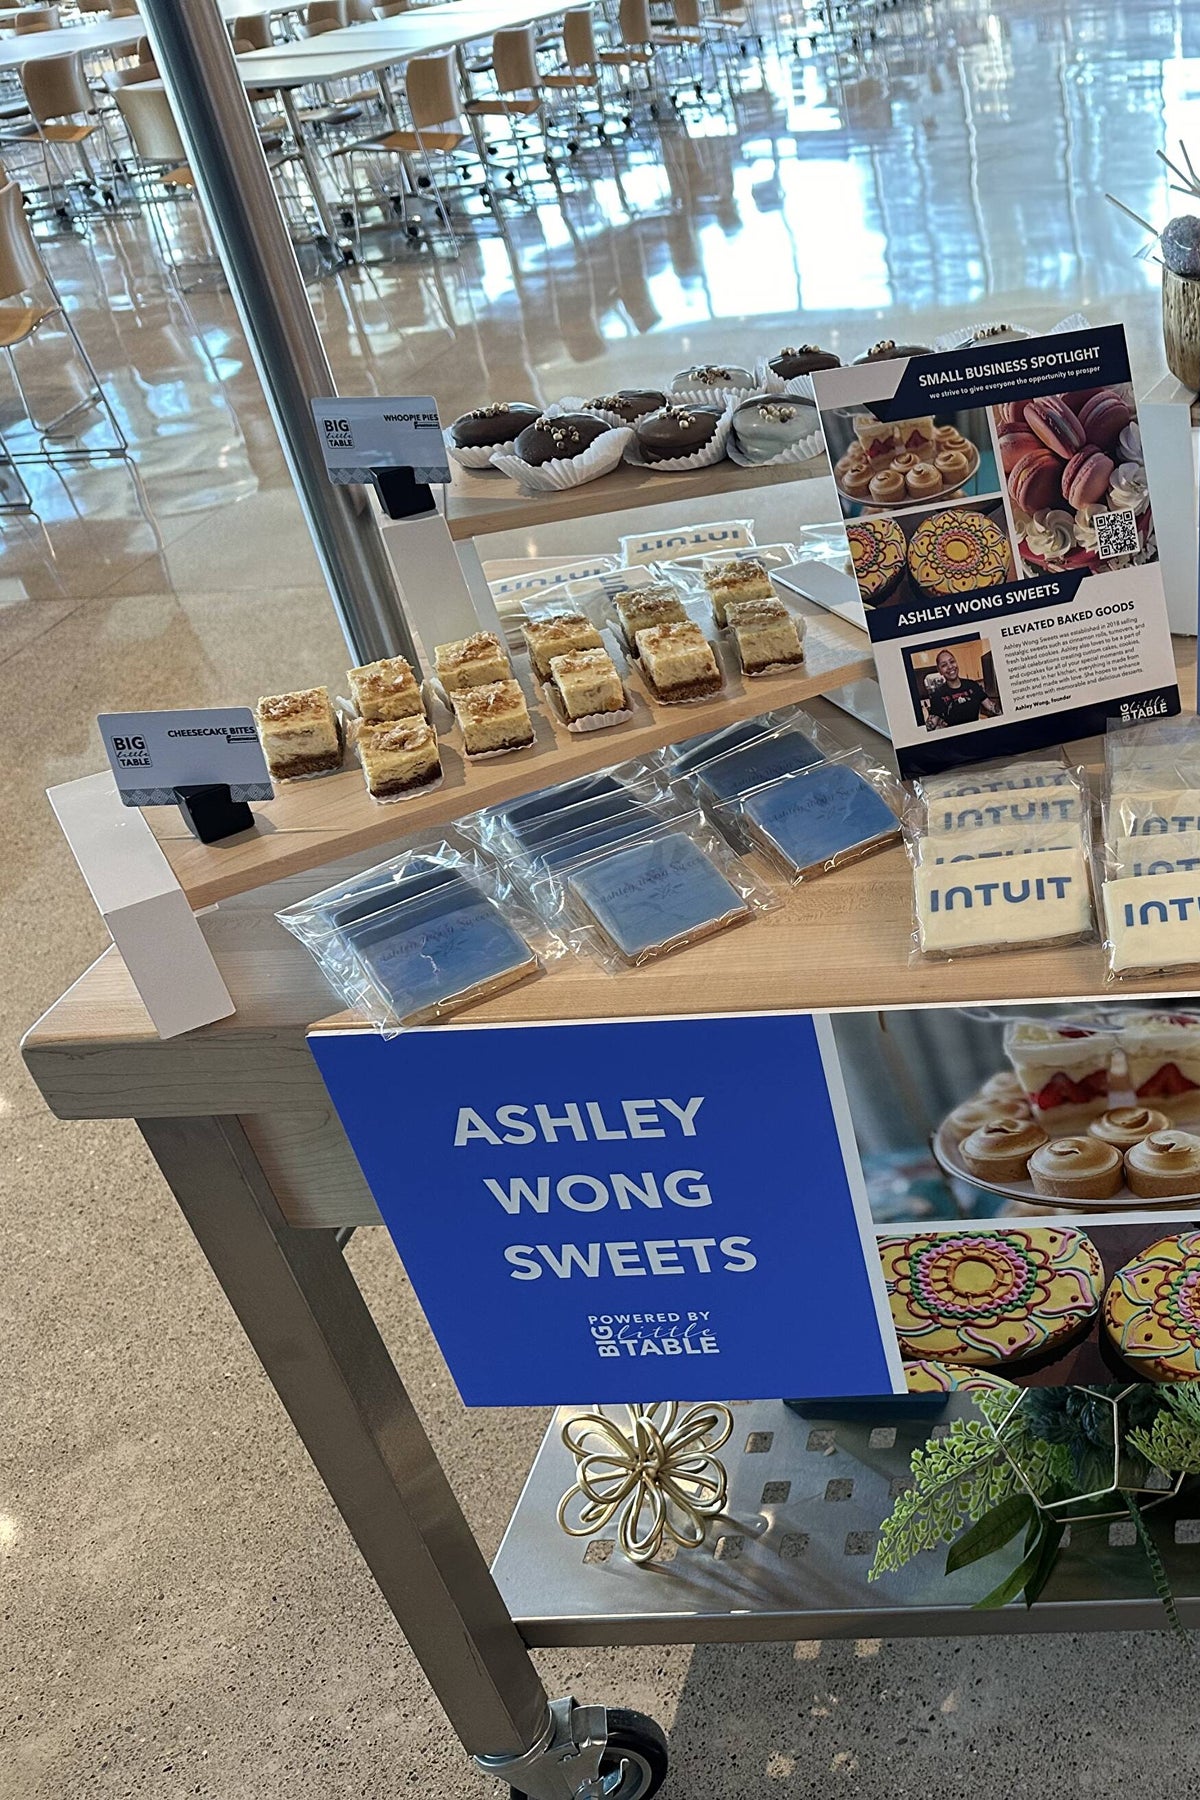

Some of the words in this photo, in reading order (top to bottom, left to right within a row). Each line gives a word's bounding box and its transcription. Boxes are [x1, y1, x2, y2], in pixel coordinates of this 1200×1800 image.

[919, 370, 964, 387] SMALL
[966, 358, 1028, 379] BUSINESS
[1031, 346, 1100, 369] SPOTLIGHT
[941, 388, 959, 398] strive
[970, 384, 984, 394] give
[985, 379, 1015, 390] everyone
[1028, 372, 1066, 384] opportunity
[1075, 365, 1100, 376] prosper
[324, 420, 349, 432] BIG
[329, 439, 353, 447] TABLE
[898, 605, 951, 626] ASHLEY
[955, 595, 1003, 616] WONG
[1006, 582, 1060, 605] SWEETS
[1001, 619, 1055, 637] ELEVATED
[1057, 610, 1093, 626] BAKED
[1095, 601, 1135, 617] GOODS
[1014, 702, 1032, 711] Ashley
[1120, 703, 1130, 722] BIG
[1131, 702, 1168, 720] TABLE
[168, 728, 228, 738] CHEESECAKE
[230, 726, 255, 735] BITES
[113, 736, 145, 750] BIG
[120, 758, 150, 767] TABLE
[944, 799, 1075, 830] INTUIT
[930, 876, 1072, 913] INTUIT
[453, 1097, 705, 1146] ASHLEY
[483, 1169, 713, 1215] WONG
[504, 1236, 758, 1281] SWEETS
[588, 1312, 680, 1325] POWERED
[688, 1311, 711, 1321] BY
[613, 1322, 717, 1339] little
[591, 1325, 620, 1357] BIG
[619, 1337, 720, 1357] TABLE
